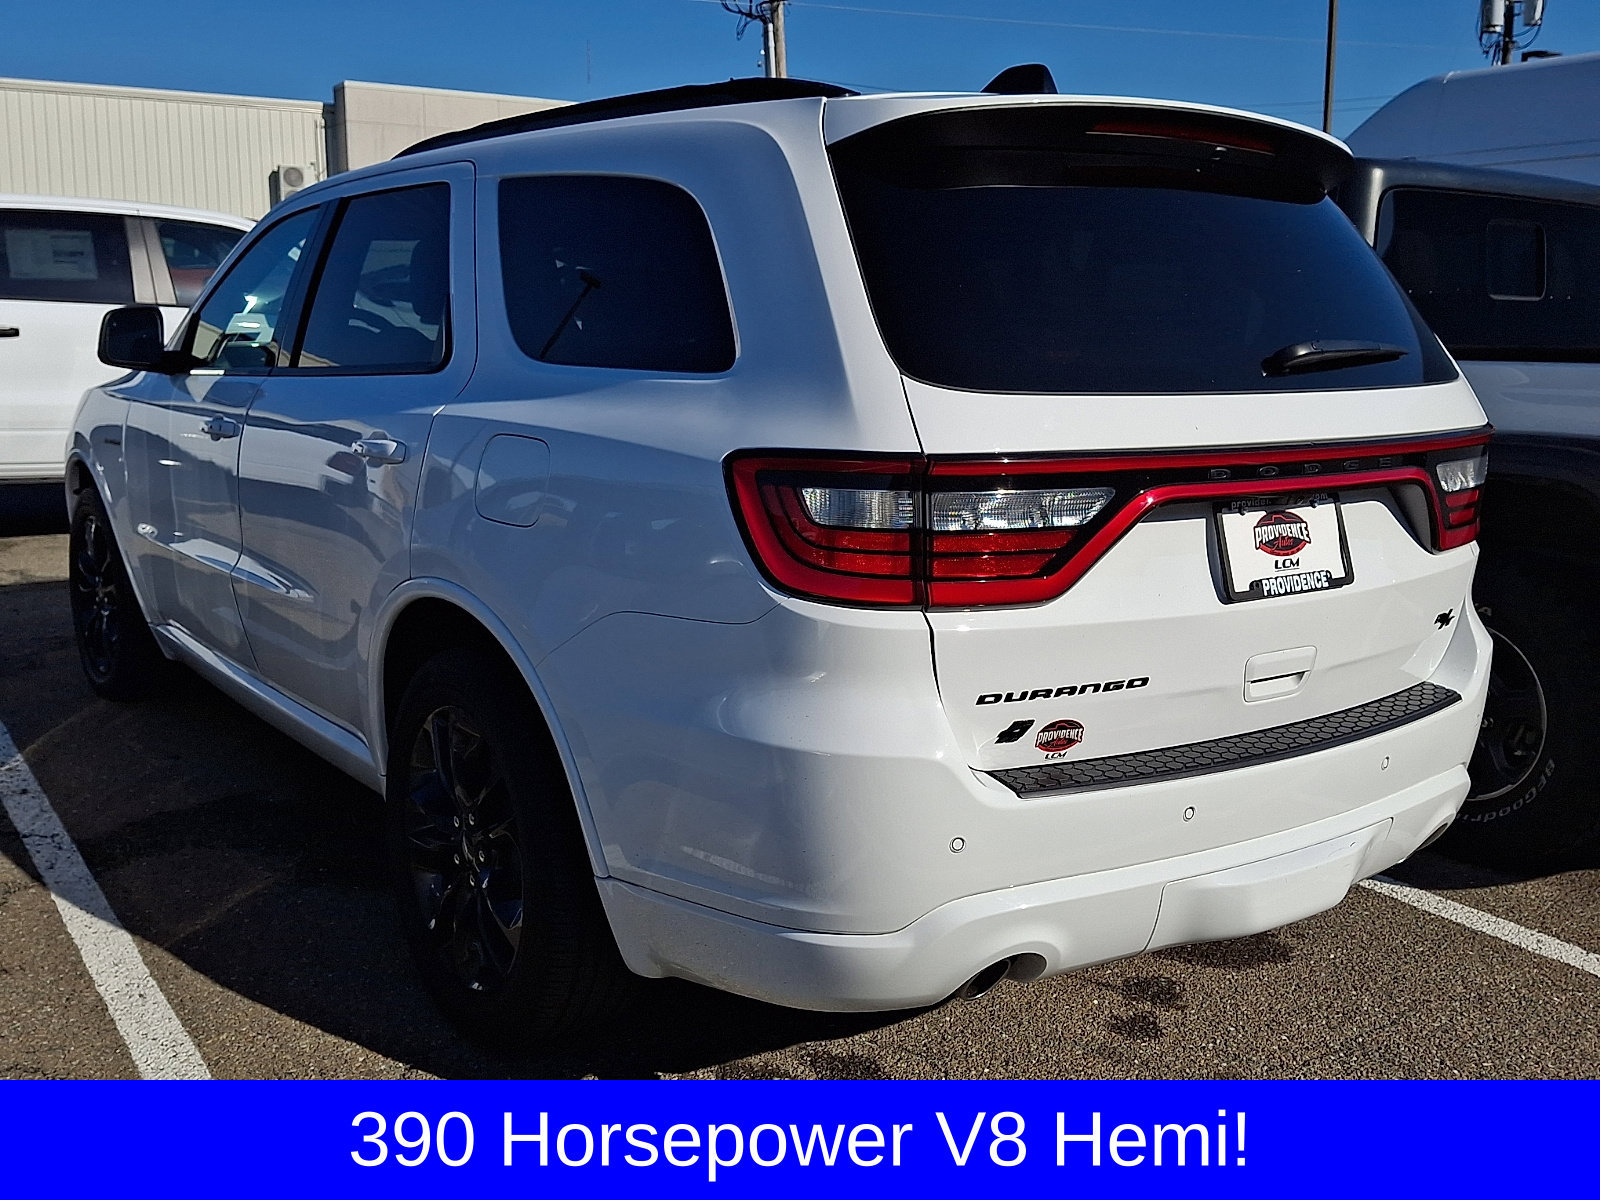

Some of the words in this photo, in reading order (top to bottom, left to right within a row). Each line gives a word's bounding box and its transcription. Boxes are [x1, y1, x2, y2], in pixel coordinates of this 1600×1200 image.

[1208, 458, 1391, 480] DODGE
[1254, 522, 1310, 549] PROVIDENCE
[1274, 557, 1299, 570] LCM
[1261, 572, 1328, 597] PROVIDENCE
[975, 677, 1150, 706] DURANGO
[1036, 728, 1084, 747] PROVIDENCE
